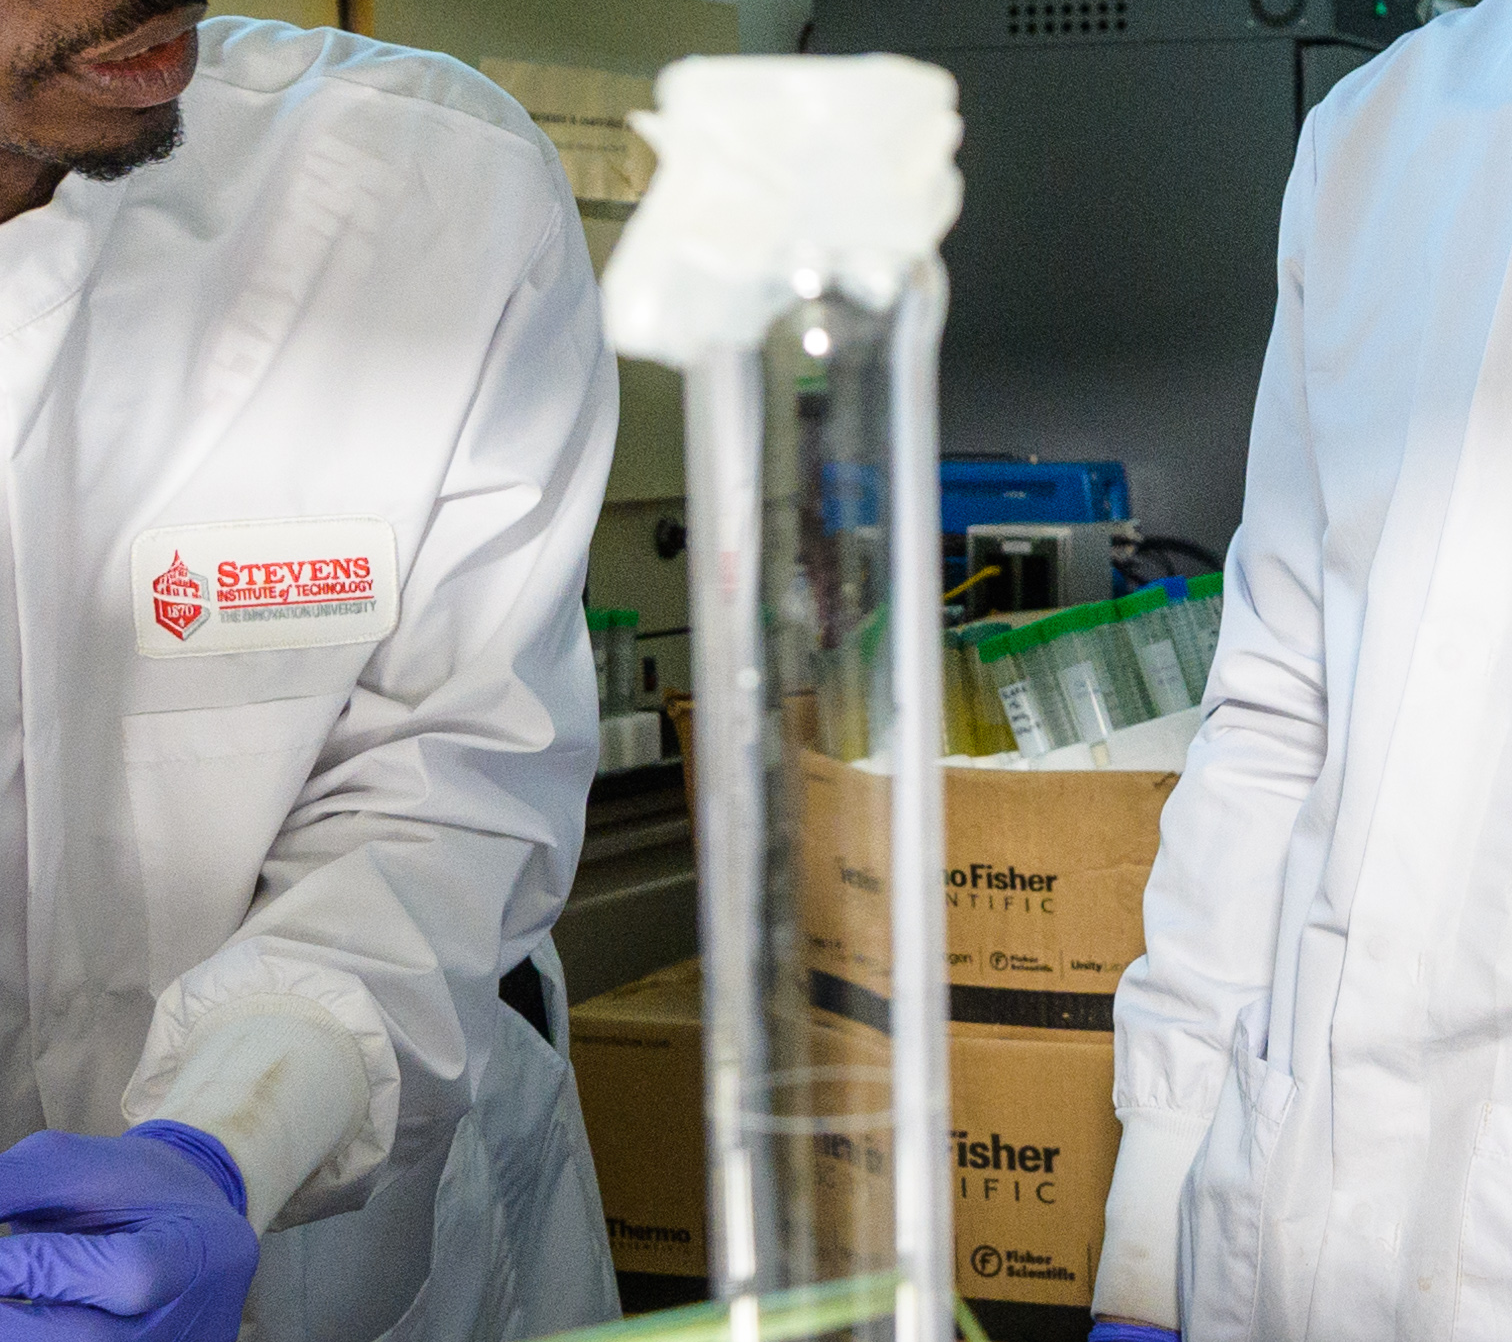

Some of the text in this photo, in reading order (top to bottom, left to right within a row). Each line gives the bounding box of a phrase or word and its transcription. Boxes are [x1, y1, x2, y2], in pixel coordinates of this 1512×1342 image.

[217, 557, 371, 588] STEVENS
[216, 579, 374, 603] INSTITUTE of TECHNOLOGY
[945, 892, 1054, 914] NTIFIC
[950, 1129, 1060, 1173] isher
[1005, 1250, 1053, 1265] Fisher
[1006, 1264, 1076, 1281] Scientific
